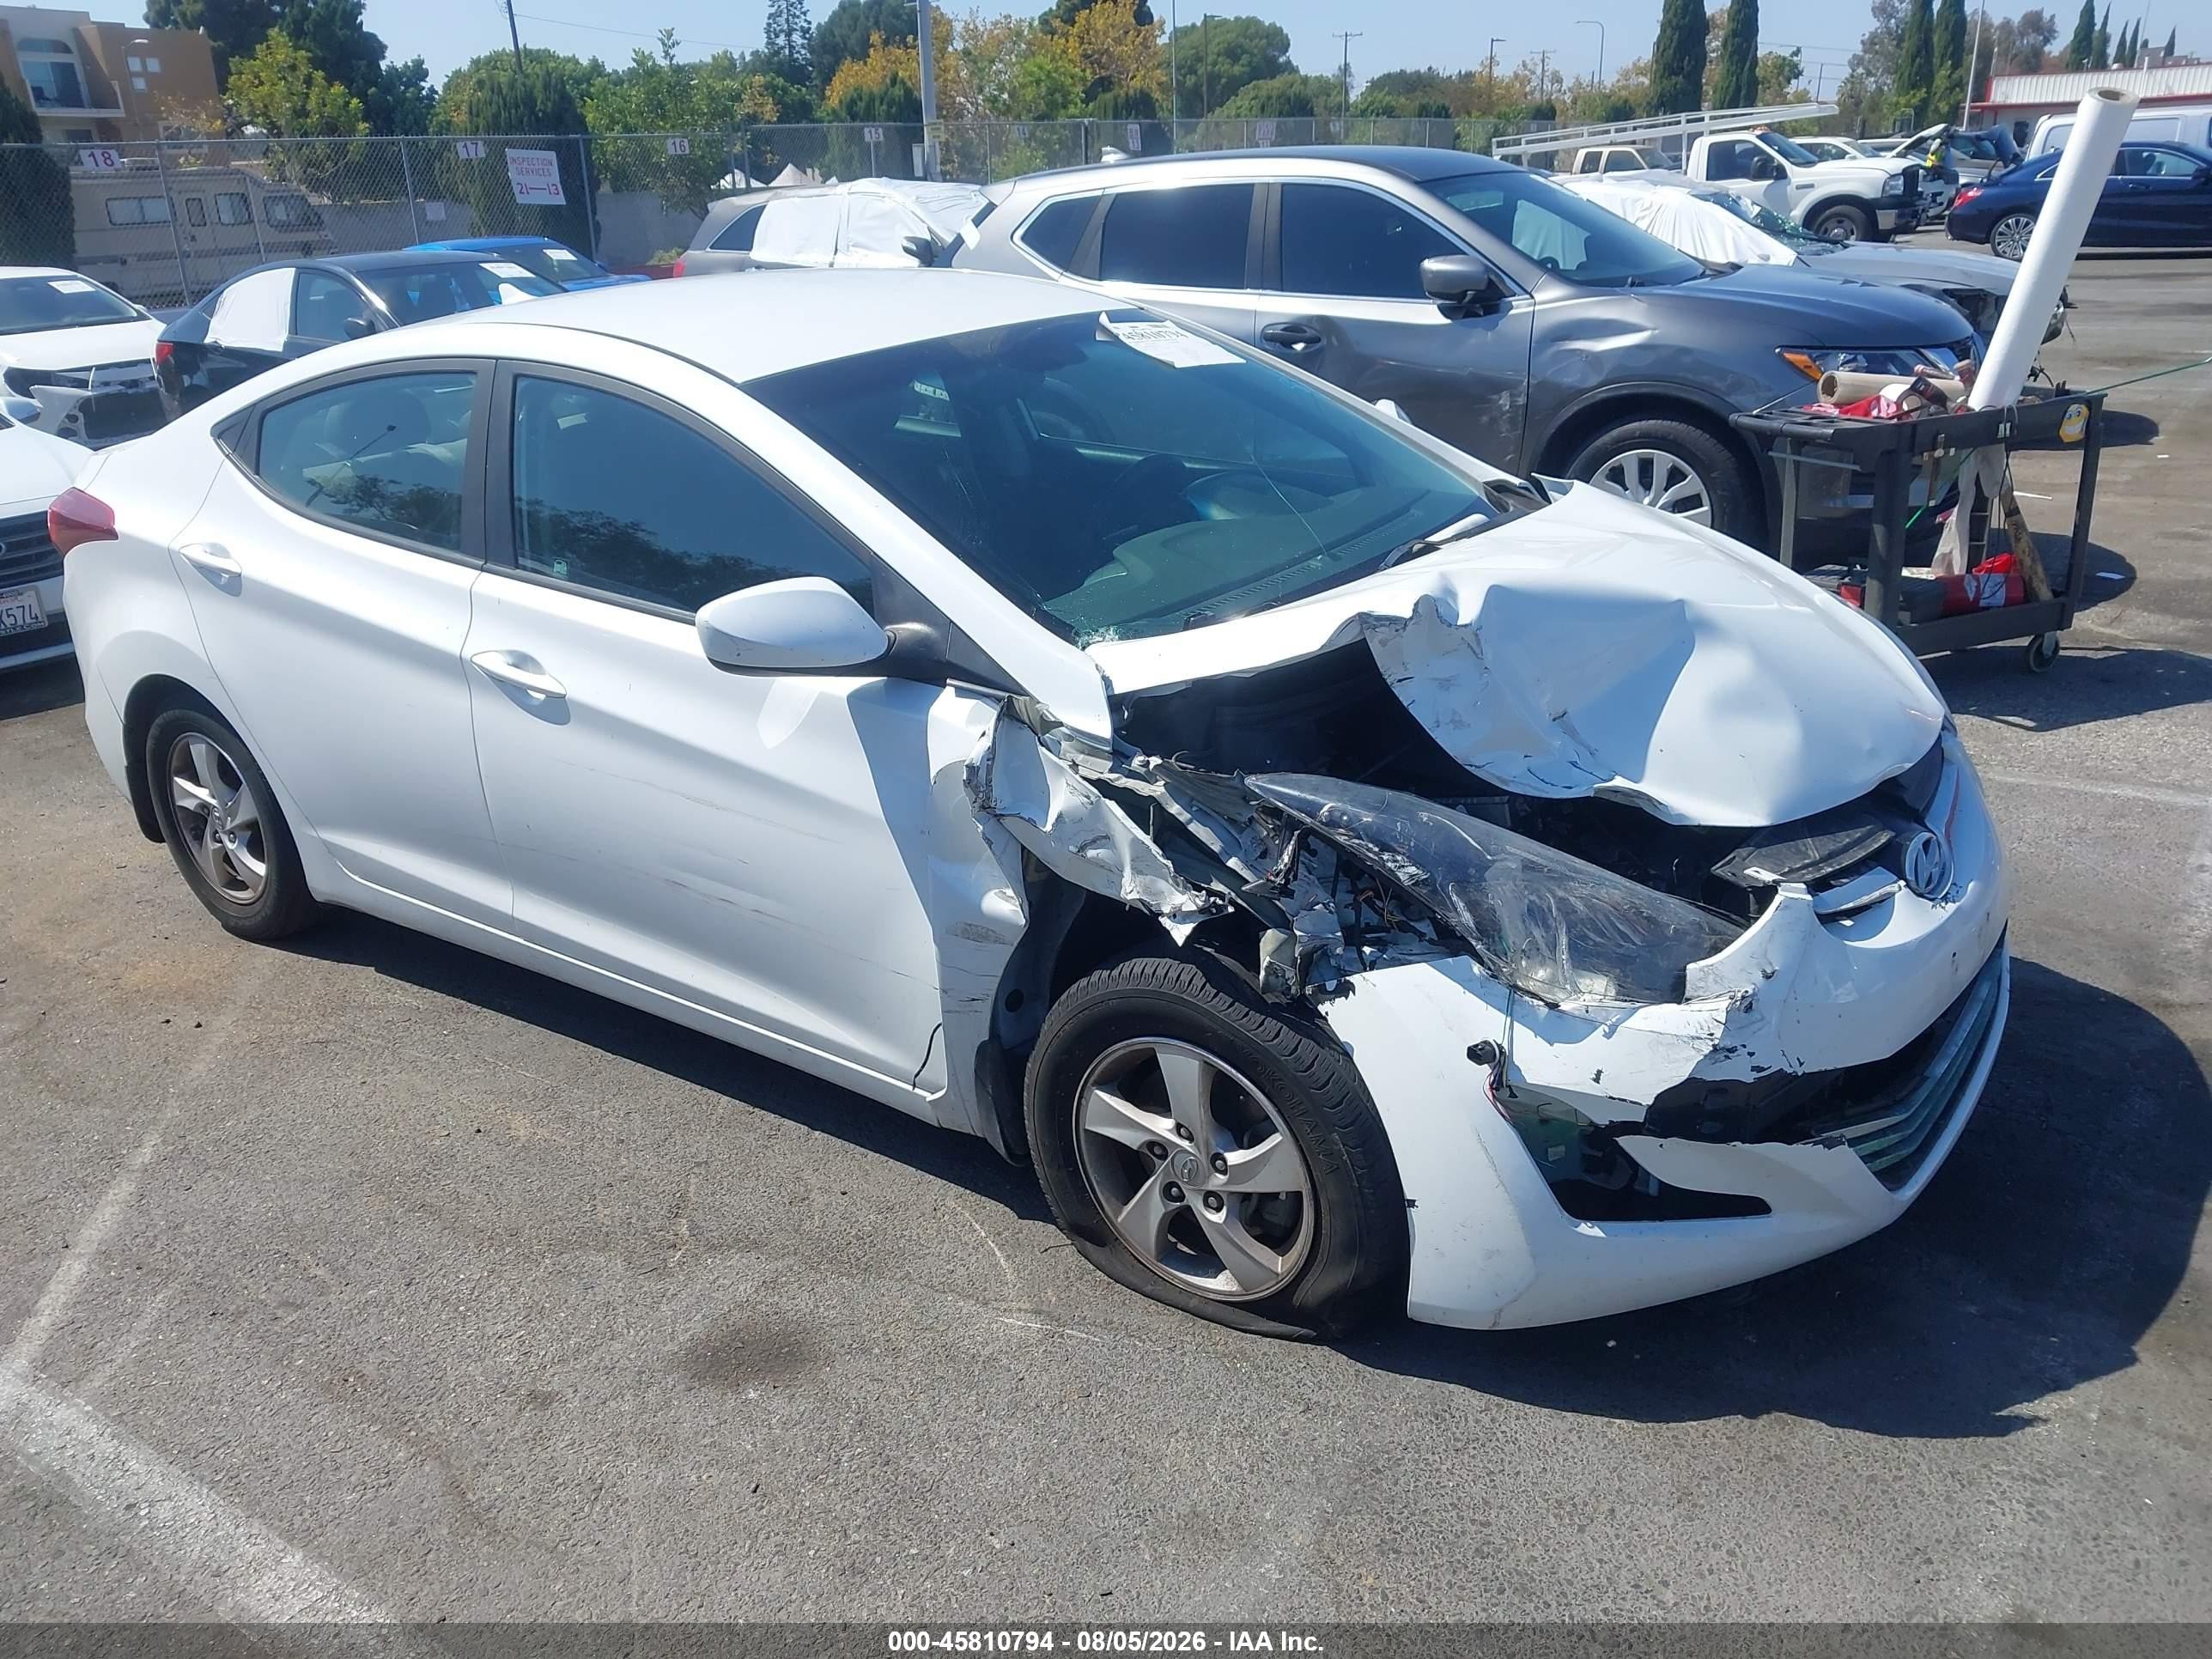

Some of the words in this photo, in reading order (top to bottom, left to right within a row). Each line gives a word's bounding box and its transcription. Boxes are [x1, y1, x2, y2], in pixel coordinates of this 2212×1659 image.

[867, 128, 880, 140] 15
[462, 142, 480, 157] 17
[672, 140, 686, 153] 16
[88, 150, 114, 167] 18
[509, 156, 554, 167] INSPECTION
[516, 167, 551, 177] SERVICES
[1241, 1044, 1340, 1175] YOKOHAMA
